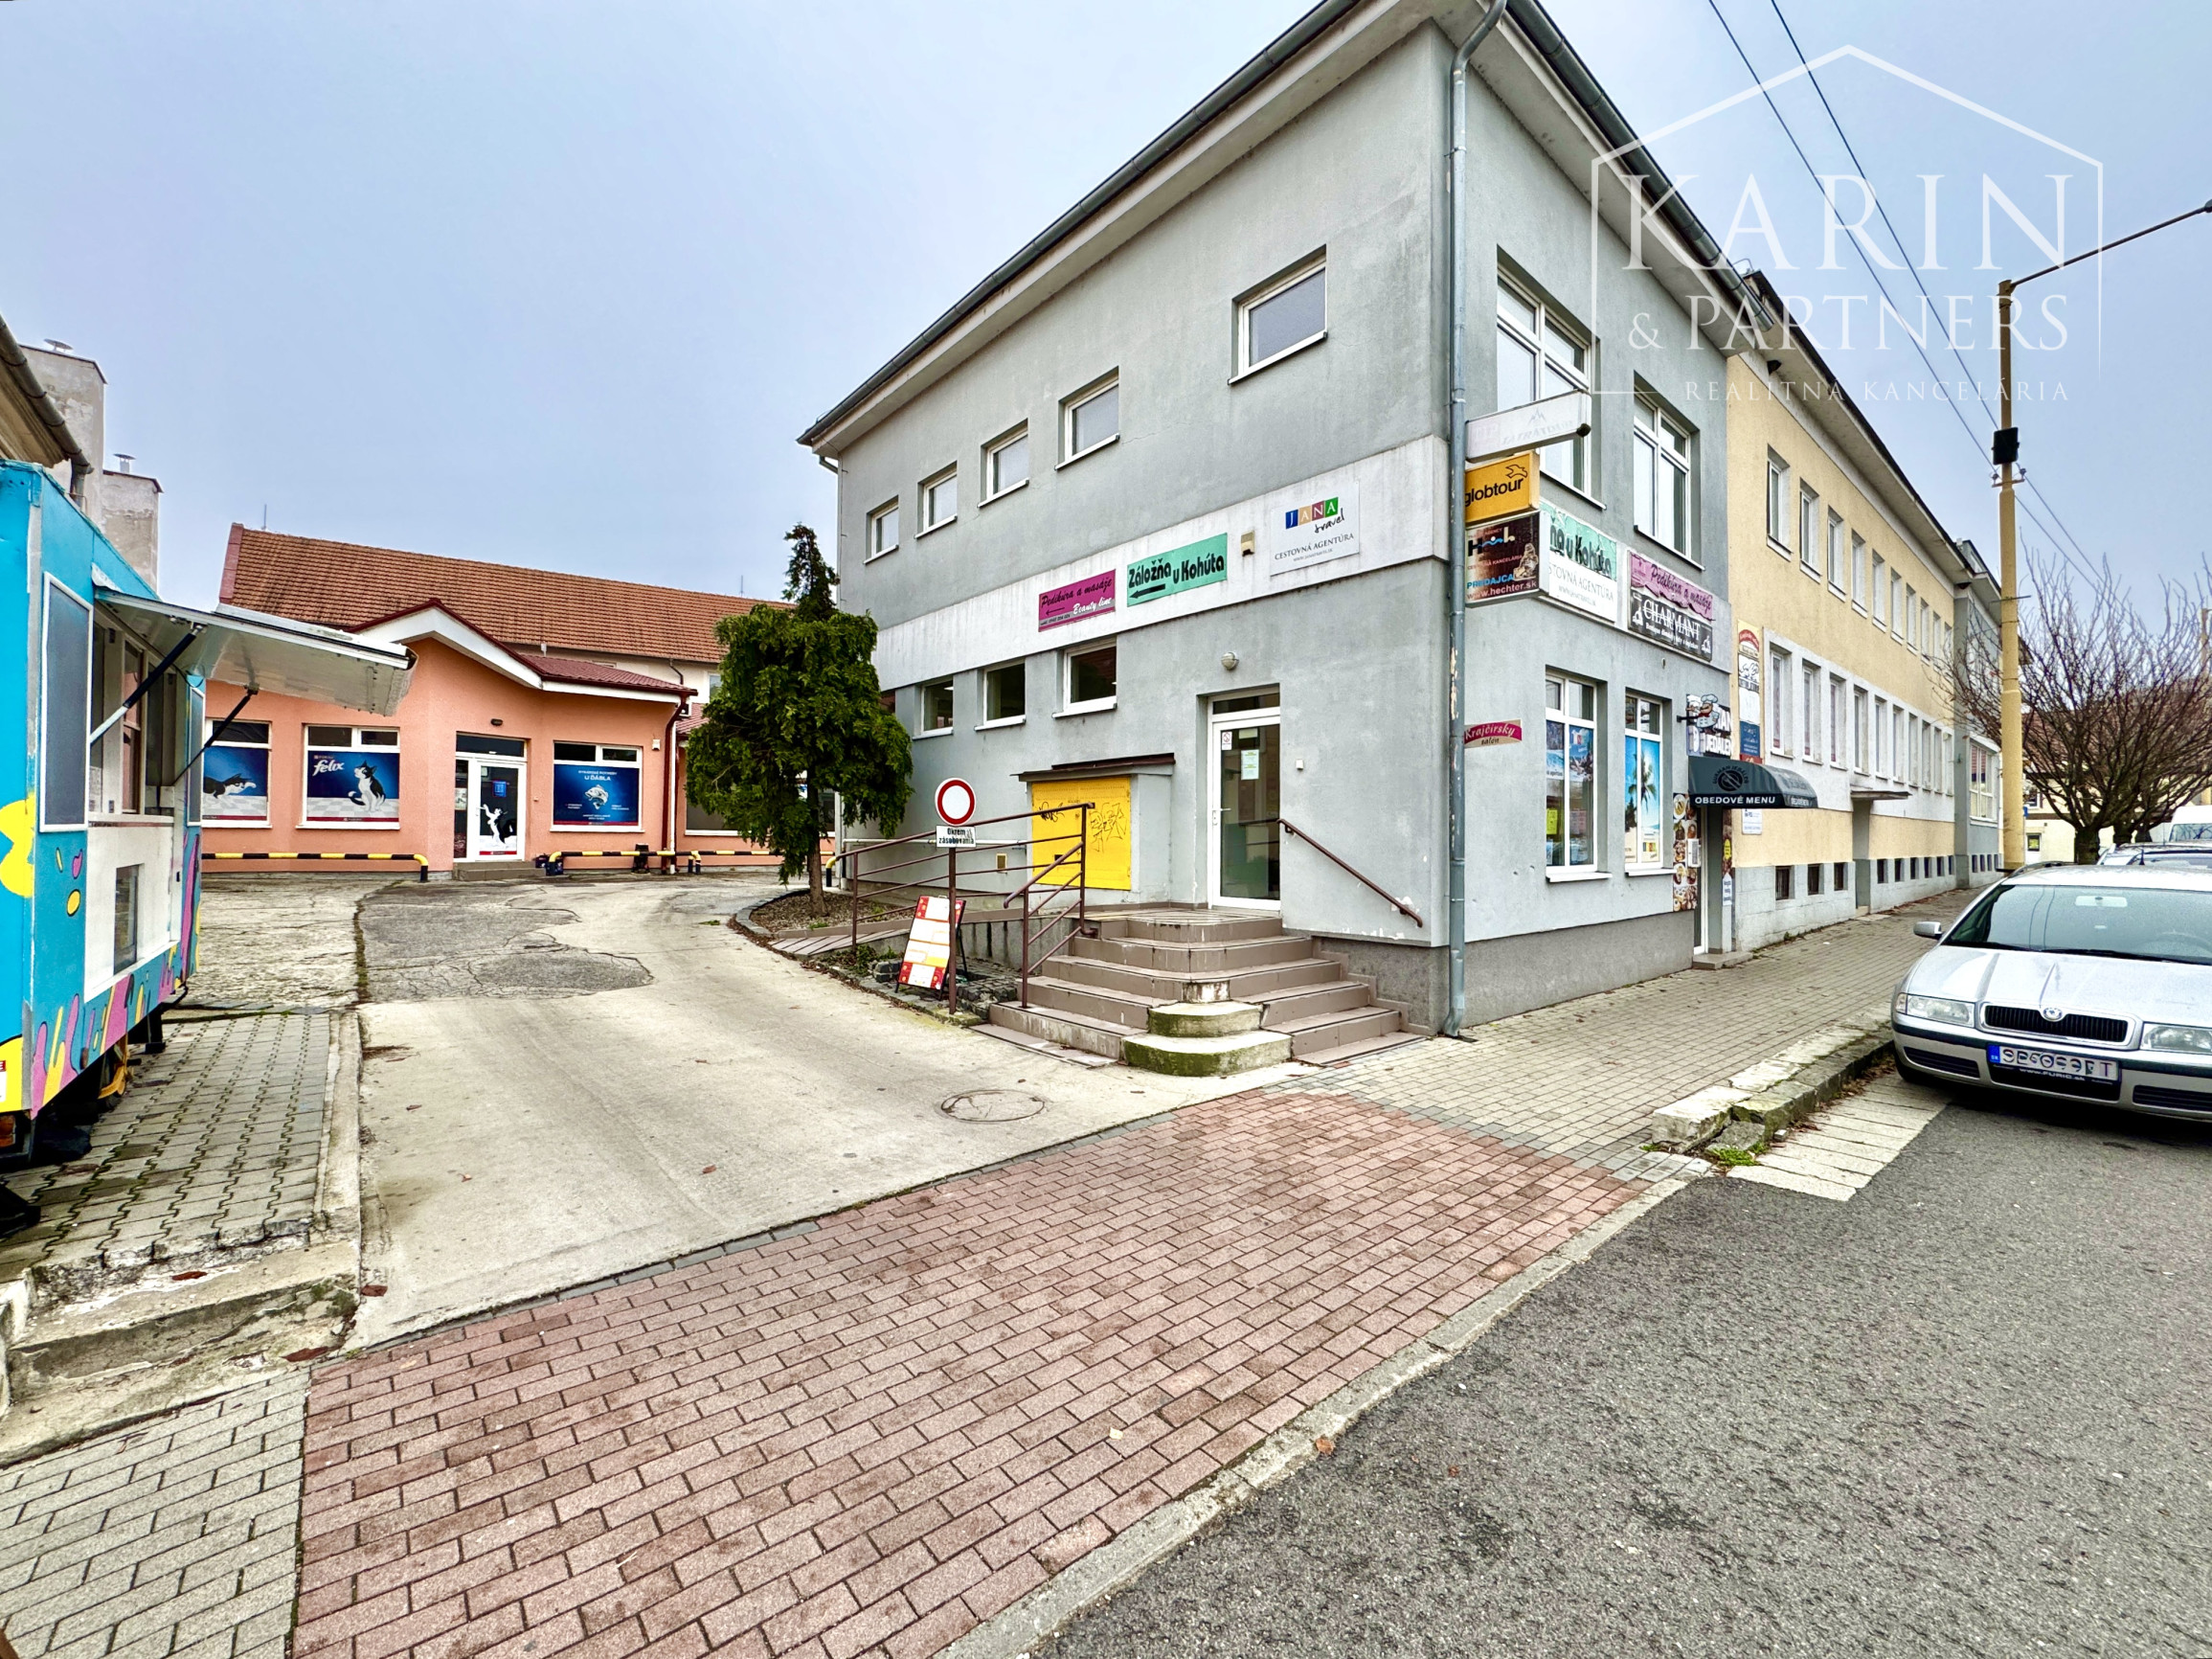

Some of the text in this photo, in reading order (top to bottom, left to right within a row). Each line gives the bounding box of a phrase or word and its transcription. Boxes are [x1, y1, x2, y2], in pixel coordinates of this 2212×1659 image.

[1464, 478, 1524, 508] globtour
[1287, 499, 1338, 528] JANA
[1314, 507, 1345, 534] travel
[1275, 542, 1312, 560] CESTOVNÁ
[1313, 533, 1354, 550] AGENTÚRA
[1128, 553, 1225, 588] Záložňa u Kohúta
[1467, 574, 1514, 589] PREDAJCA
[1041, 590, 1073, 608] Pedikúra
[1084, 577, 1112, 593] masáže
[1467, 580, 1537, 600] www.hechter.sk
[1072, 596, 1112, 614] Beauty line
[1643, 599, 1701, 641] CHARMANT
[312, 760, 345, 777] felix
[1694, 794, 1776, 805] OBEDOVÉ MENU
